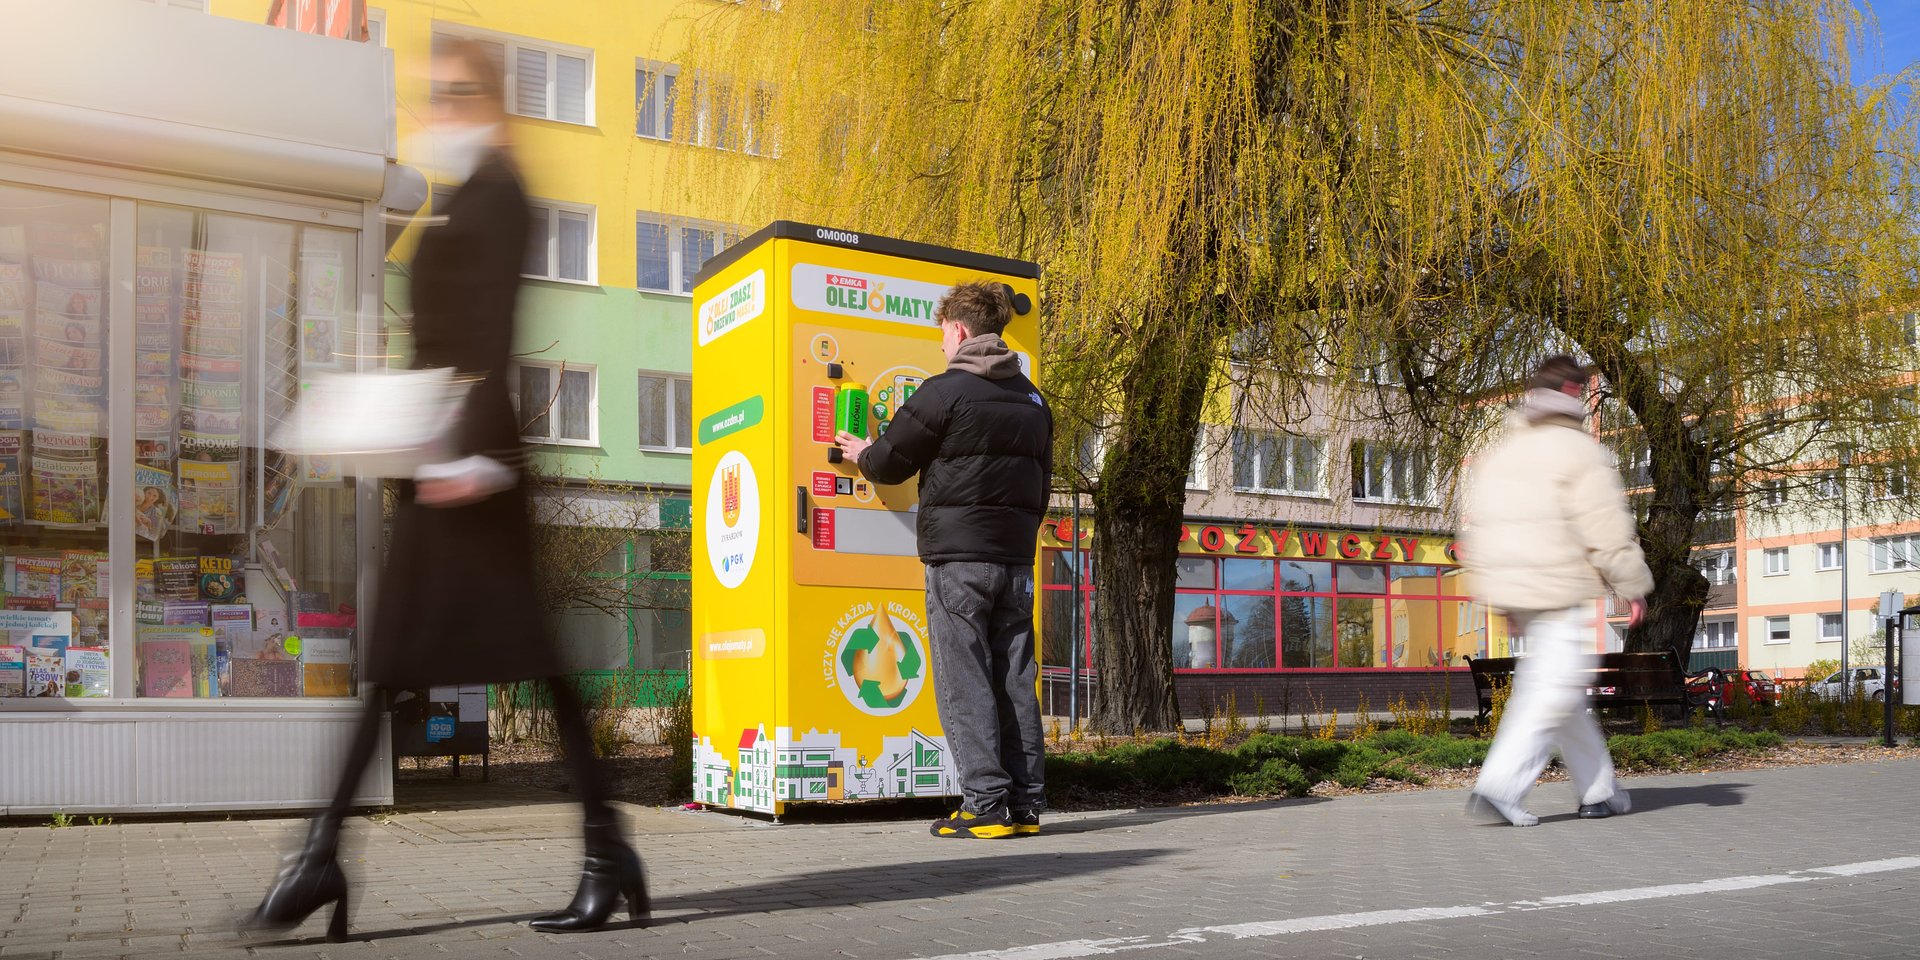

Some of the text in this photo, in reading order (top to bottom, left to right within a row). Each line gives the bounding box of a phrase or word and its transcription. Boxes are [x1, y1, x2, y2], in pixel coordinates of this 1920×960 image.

[816, 229, 859, 245] OM0008
[839, 277, 863, 288] EMKA
[729, 283, 752, 310] ZDASZ
[713, 310, 736, 332] DRZEWKO
[183, 382, 238, 398] HARMONIA
[37, 432, 88, 447] Ogródek
[179, 435, 239, 449] ZDROWIE
[34, 458, 95, 473] działkowiec
[1179, 523, 1419, 561] OŻYWCZY
[16, 557, 61, 569] KRZYŻÓWKI
[199, 557, 232, 569] KETO
[730, 552, 744, 567] PGK
[837, 601, 874, 628] KAŻDA
[826, 627, 843, 648] SIĘ
[823, 650, 836, 689] LICZY
[440, 723, 452, 731] GB
